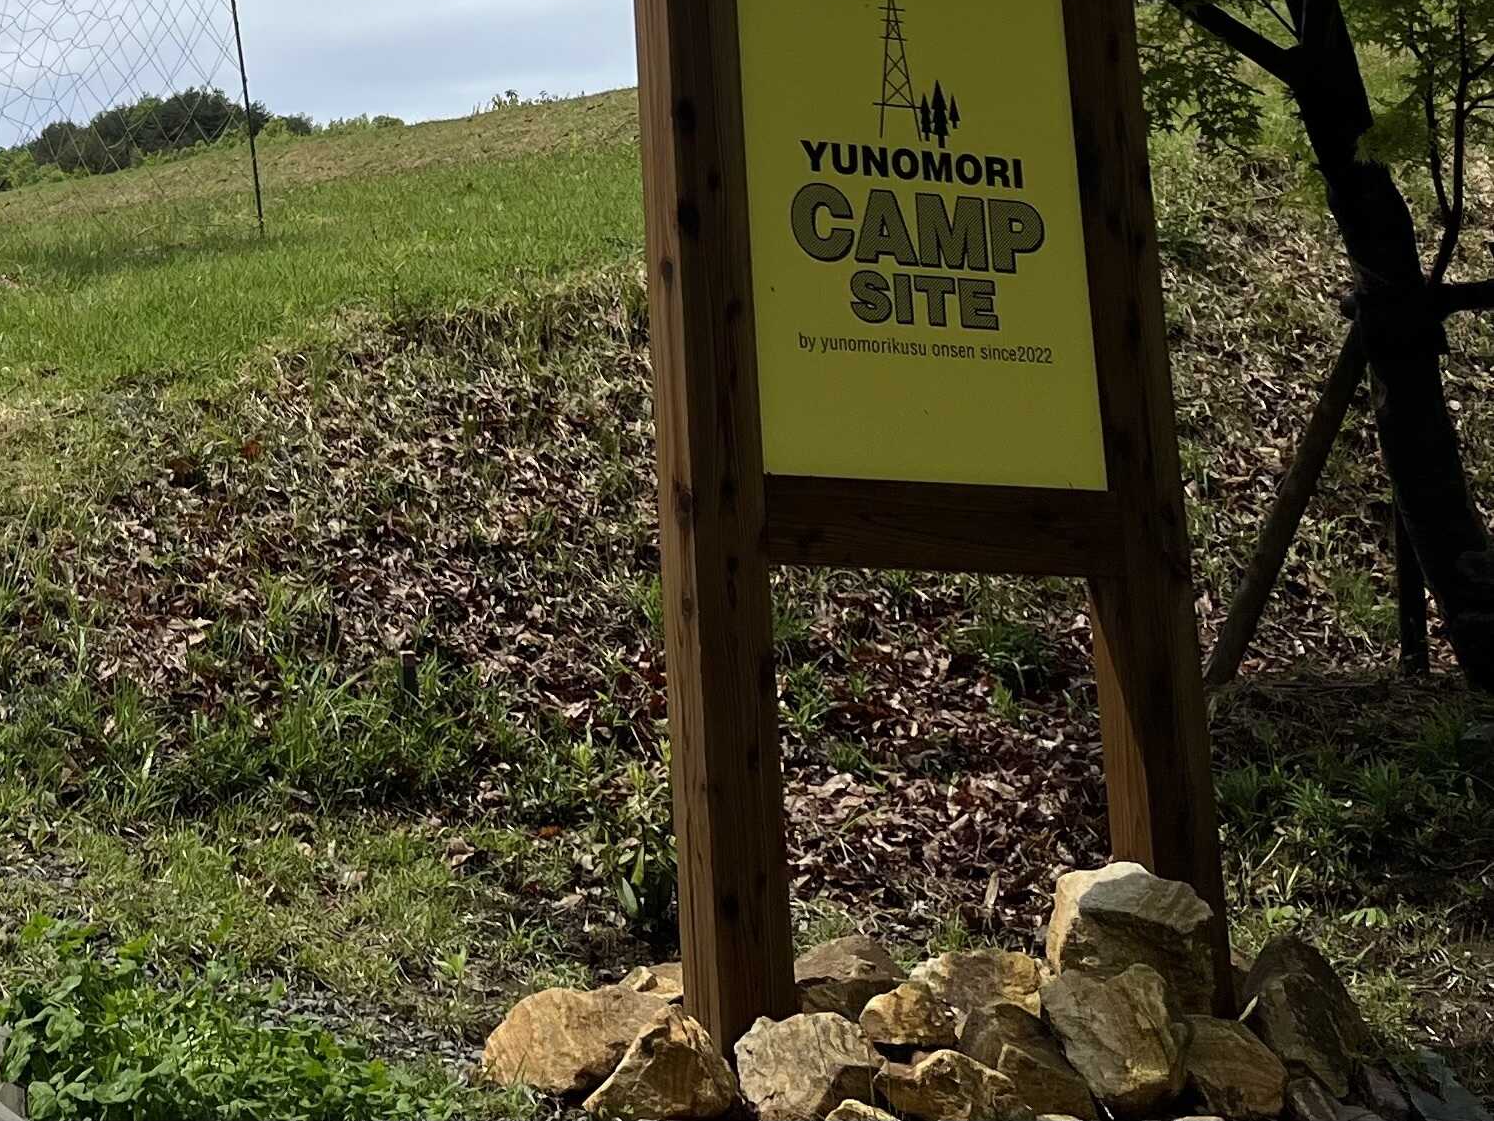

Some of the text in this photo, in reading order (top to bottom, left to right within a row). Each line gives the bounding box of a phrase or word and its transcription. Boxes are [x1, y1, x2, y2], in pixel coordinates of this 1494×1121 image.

[800, 140, 1024, 189] YUNOMORI
[791, 182, 1044, 274] CAMP
[850, 270, 1000, 331] SITE
[798, 332, 1053, 364] by yunomorikusu onsen since2022
